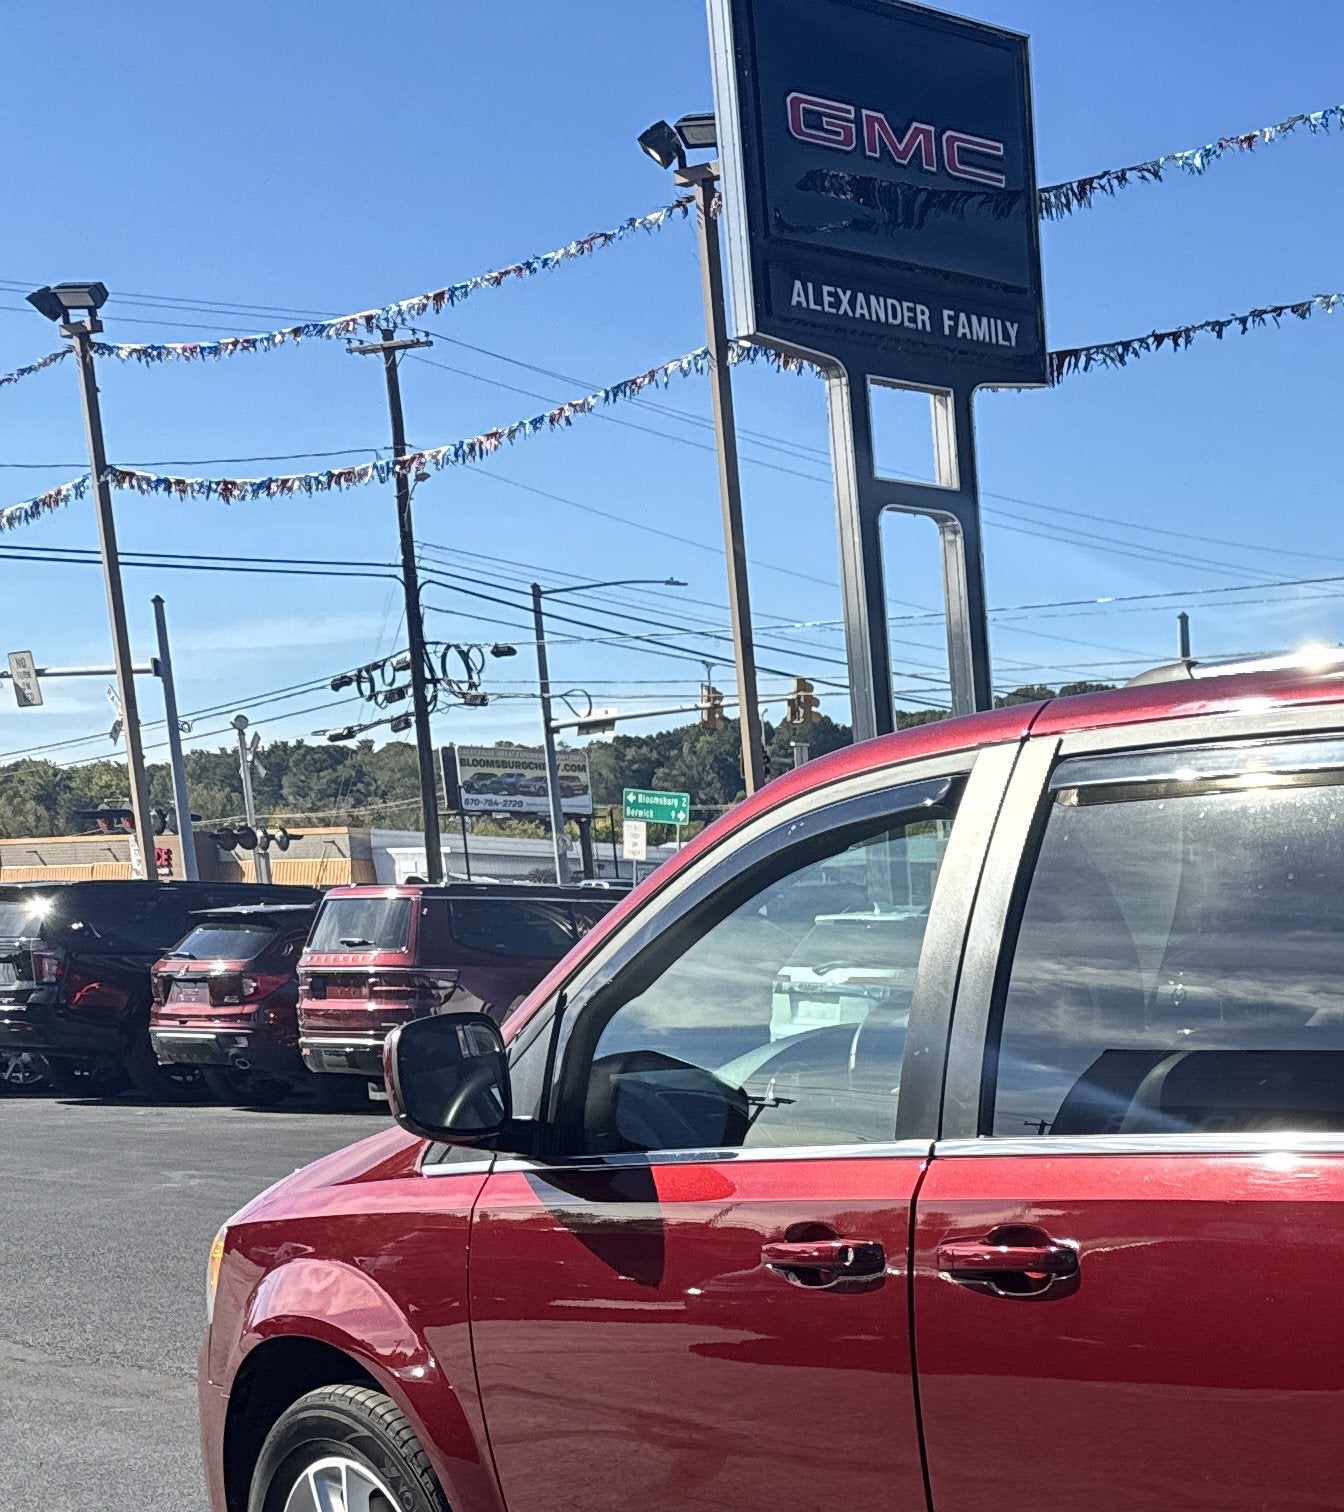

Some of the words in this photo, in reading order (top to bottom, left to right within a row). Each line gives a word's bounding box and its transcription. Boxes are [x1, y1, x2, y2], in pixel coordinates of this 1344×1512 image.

[786, 91, 1006, 189] GMC
[791, 279, 931, 333] ALEXANDER
[942, 308, 1019, 348] FAMILY
[14, 656, 27, 669] NO
[460, 757, 587, 773] BLOOMSBURGCHE.COM
[637, 793, 679, 808] Bloomsburg
[681, 797, 687, 808] 2
[626, 806, 654, 819] Berwick
